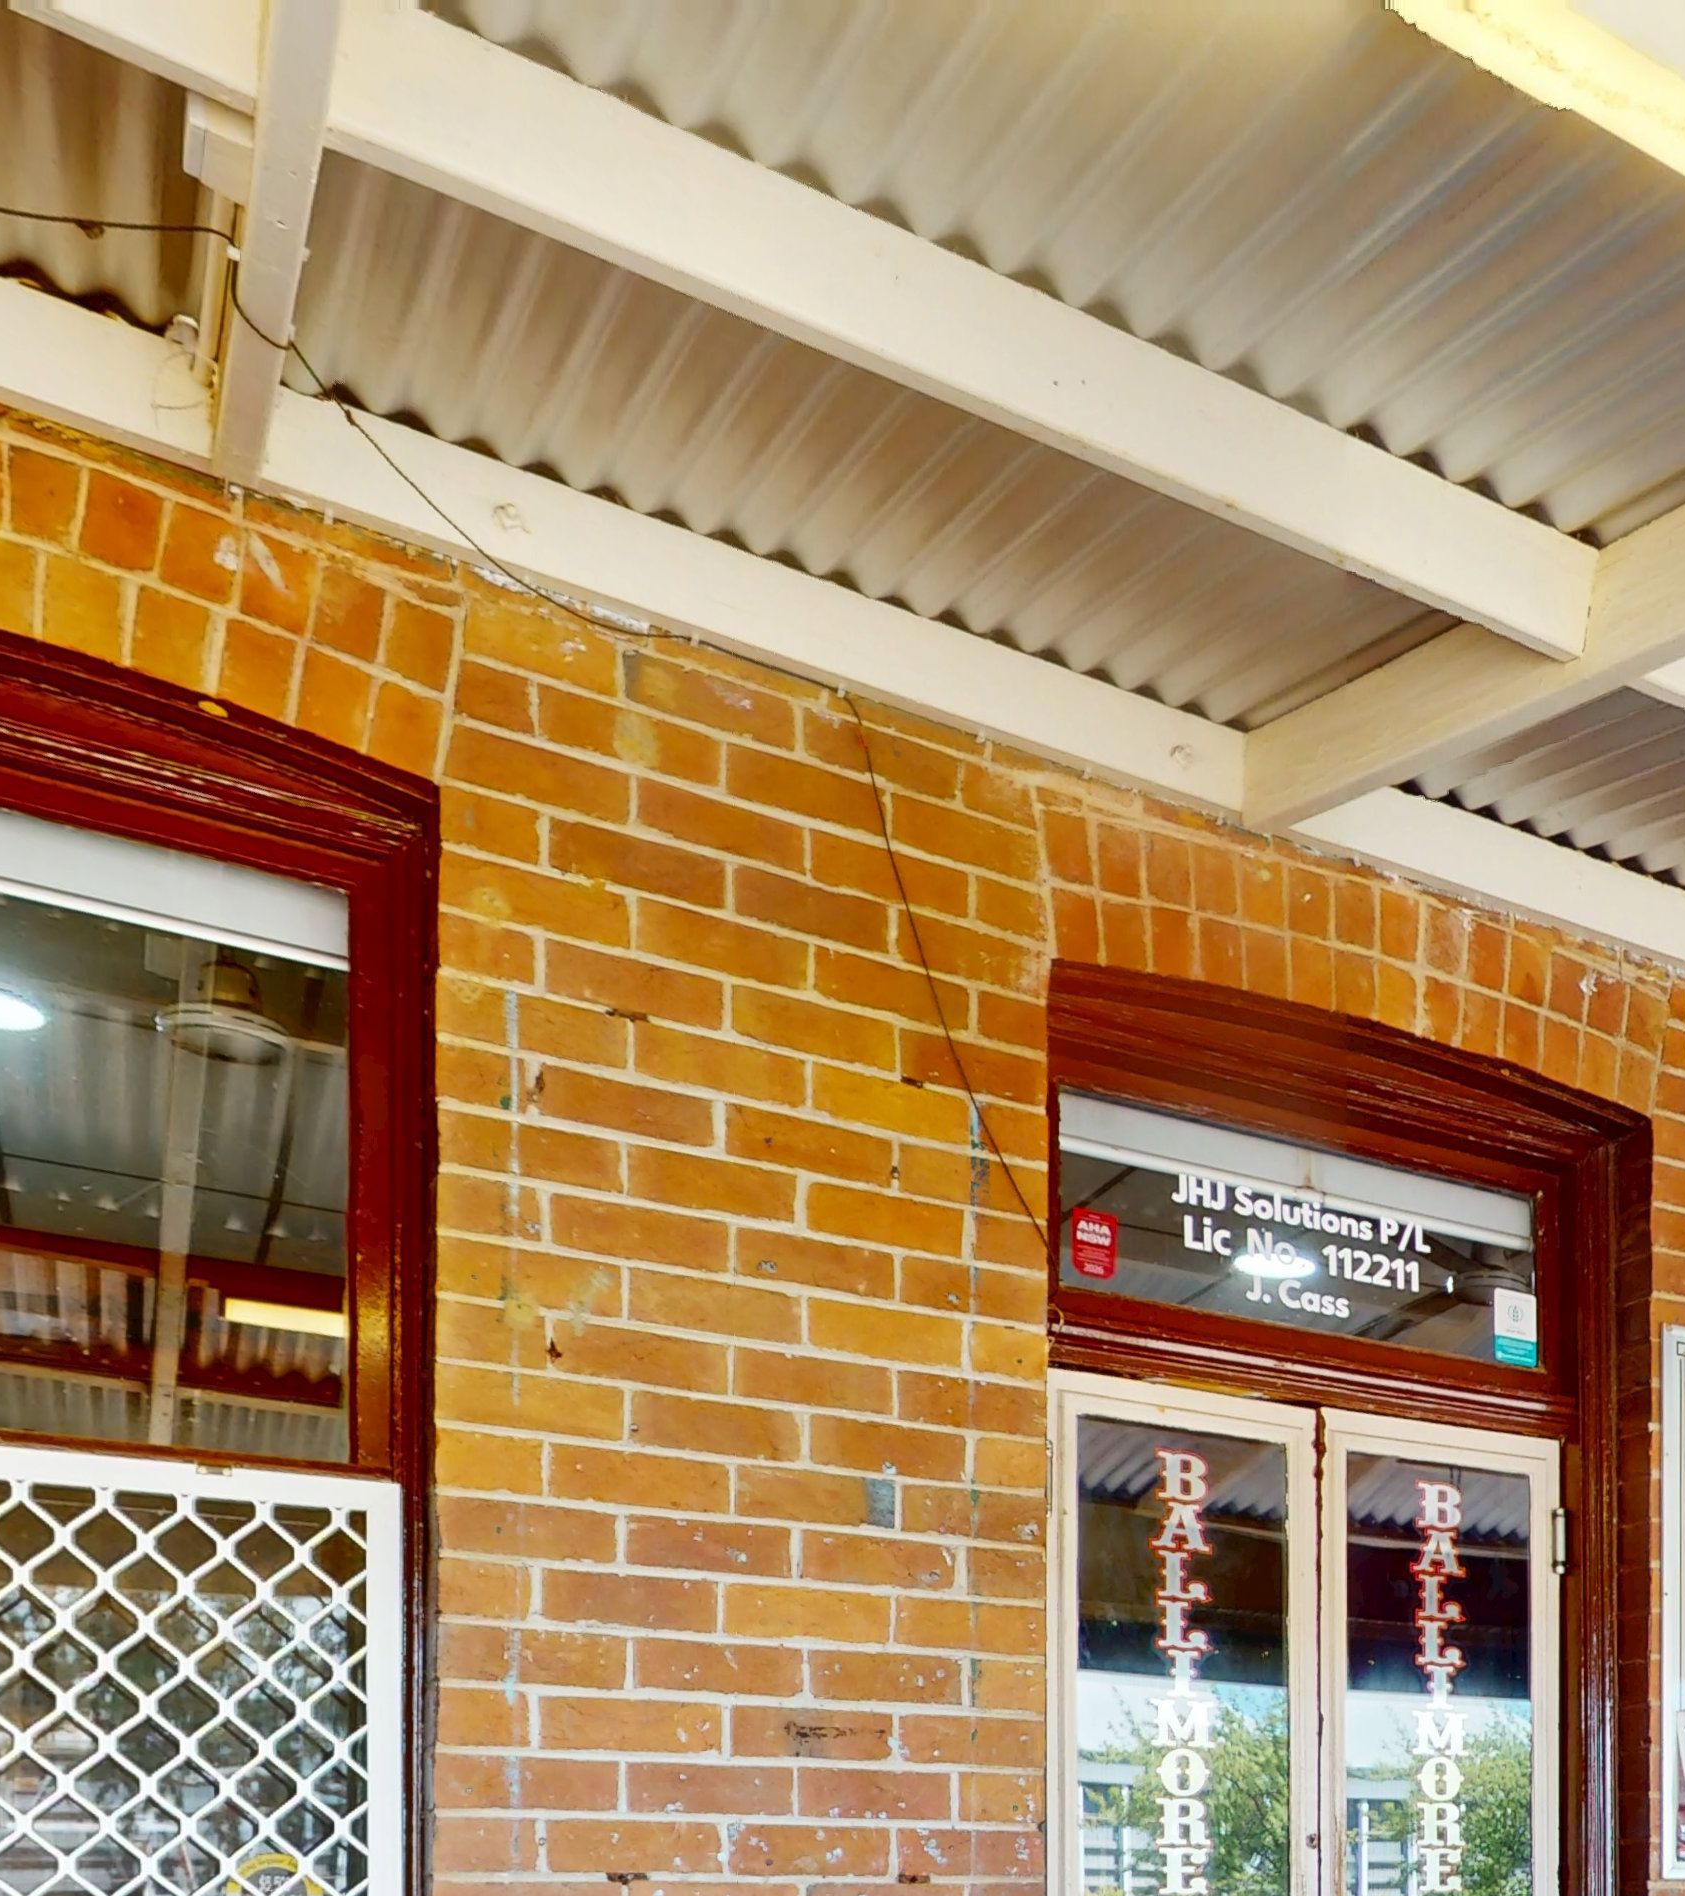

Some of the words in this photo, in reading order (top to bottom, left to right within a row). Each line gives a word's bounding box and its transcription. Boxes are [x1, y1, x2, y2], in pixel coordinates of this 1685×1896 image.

[1171, 1173, 1226, 1211] JHJ
[1233, 1186, 1374, 1241] Solutions
[1379, 1216, 1432, 1253] P/L
[1182, 1214, 1232, 1256] Lic
[1322, 1244, 1421, 1293] 112211
[1245, 1276, 1272, 1304] J.
[1278, 1279, 1350, 1318] Cass
[1151, 1447, 1215, 1896] BALLIMORE
[1412, 1480, 1467, 1894] BALLIMORE
